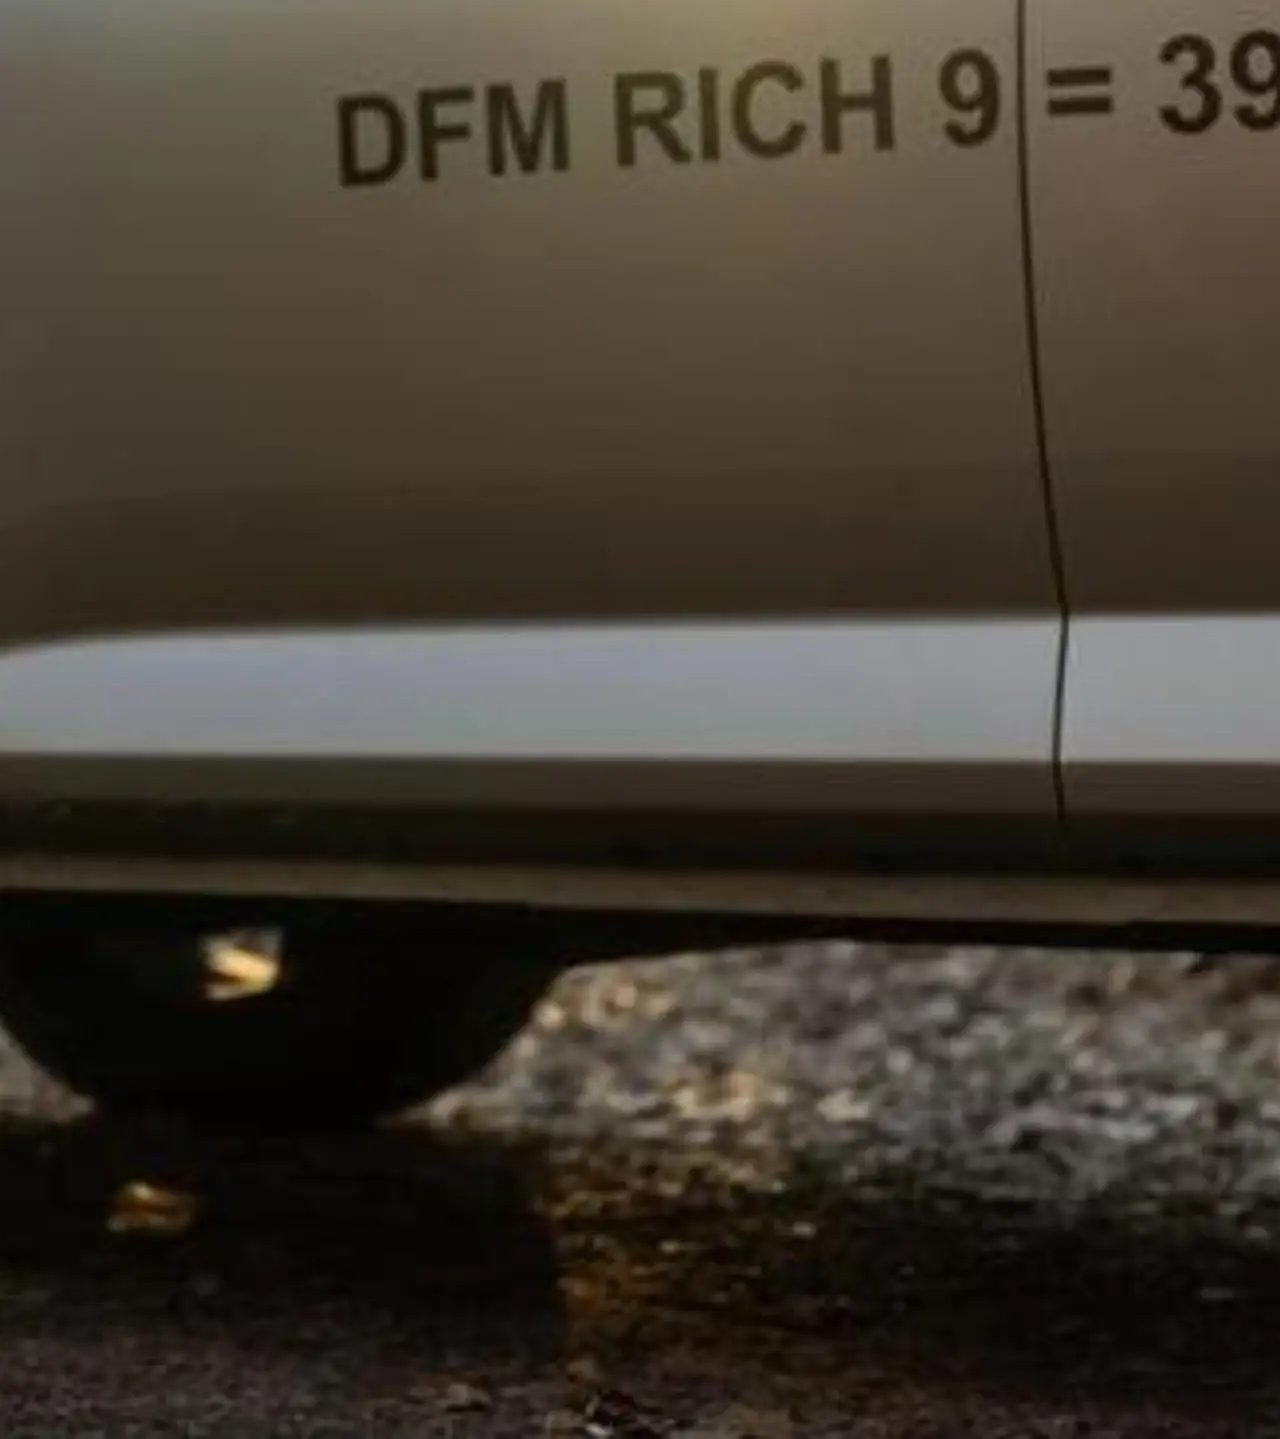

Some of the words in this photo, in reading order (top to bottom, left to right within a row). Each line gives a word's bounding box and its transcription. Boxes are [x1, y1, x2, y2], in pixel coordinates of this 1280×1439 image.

[336, 75, 570, 188] DFM
[612, 53, 894, 167] RICH
[938, 48, 1001, 148] 9
[1046, 67, 1114, 118] =
